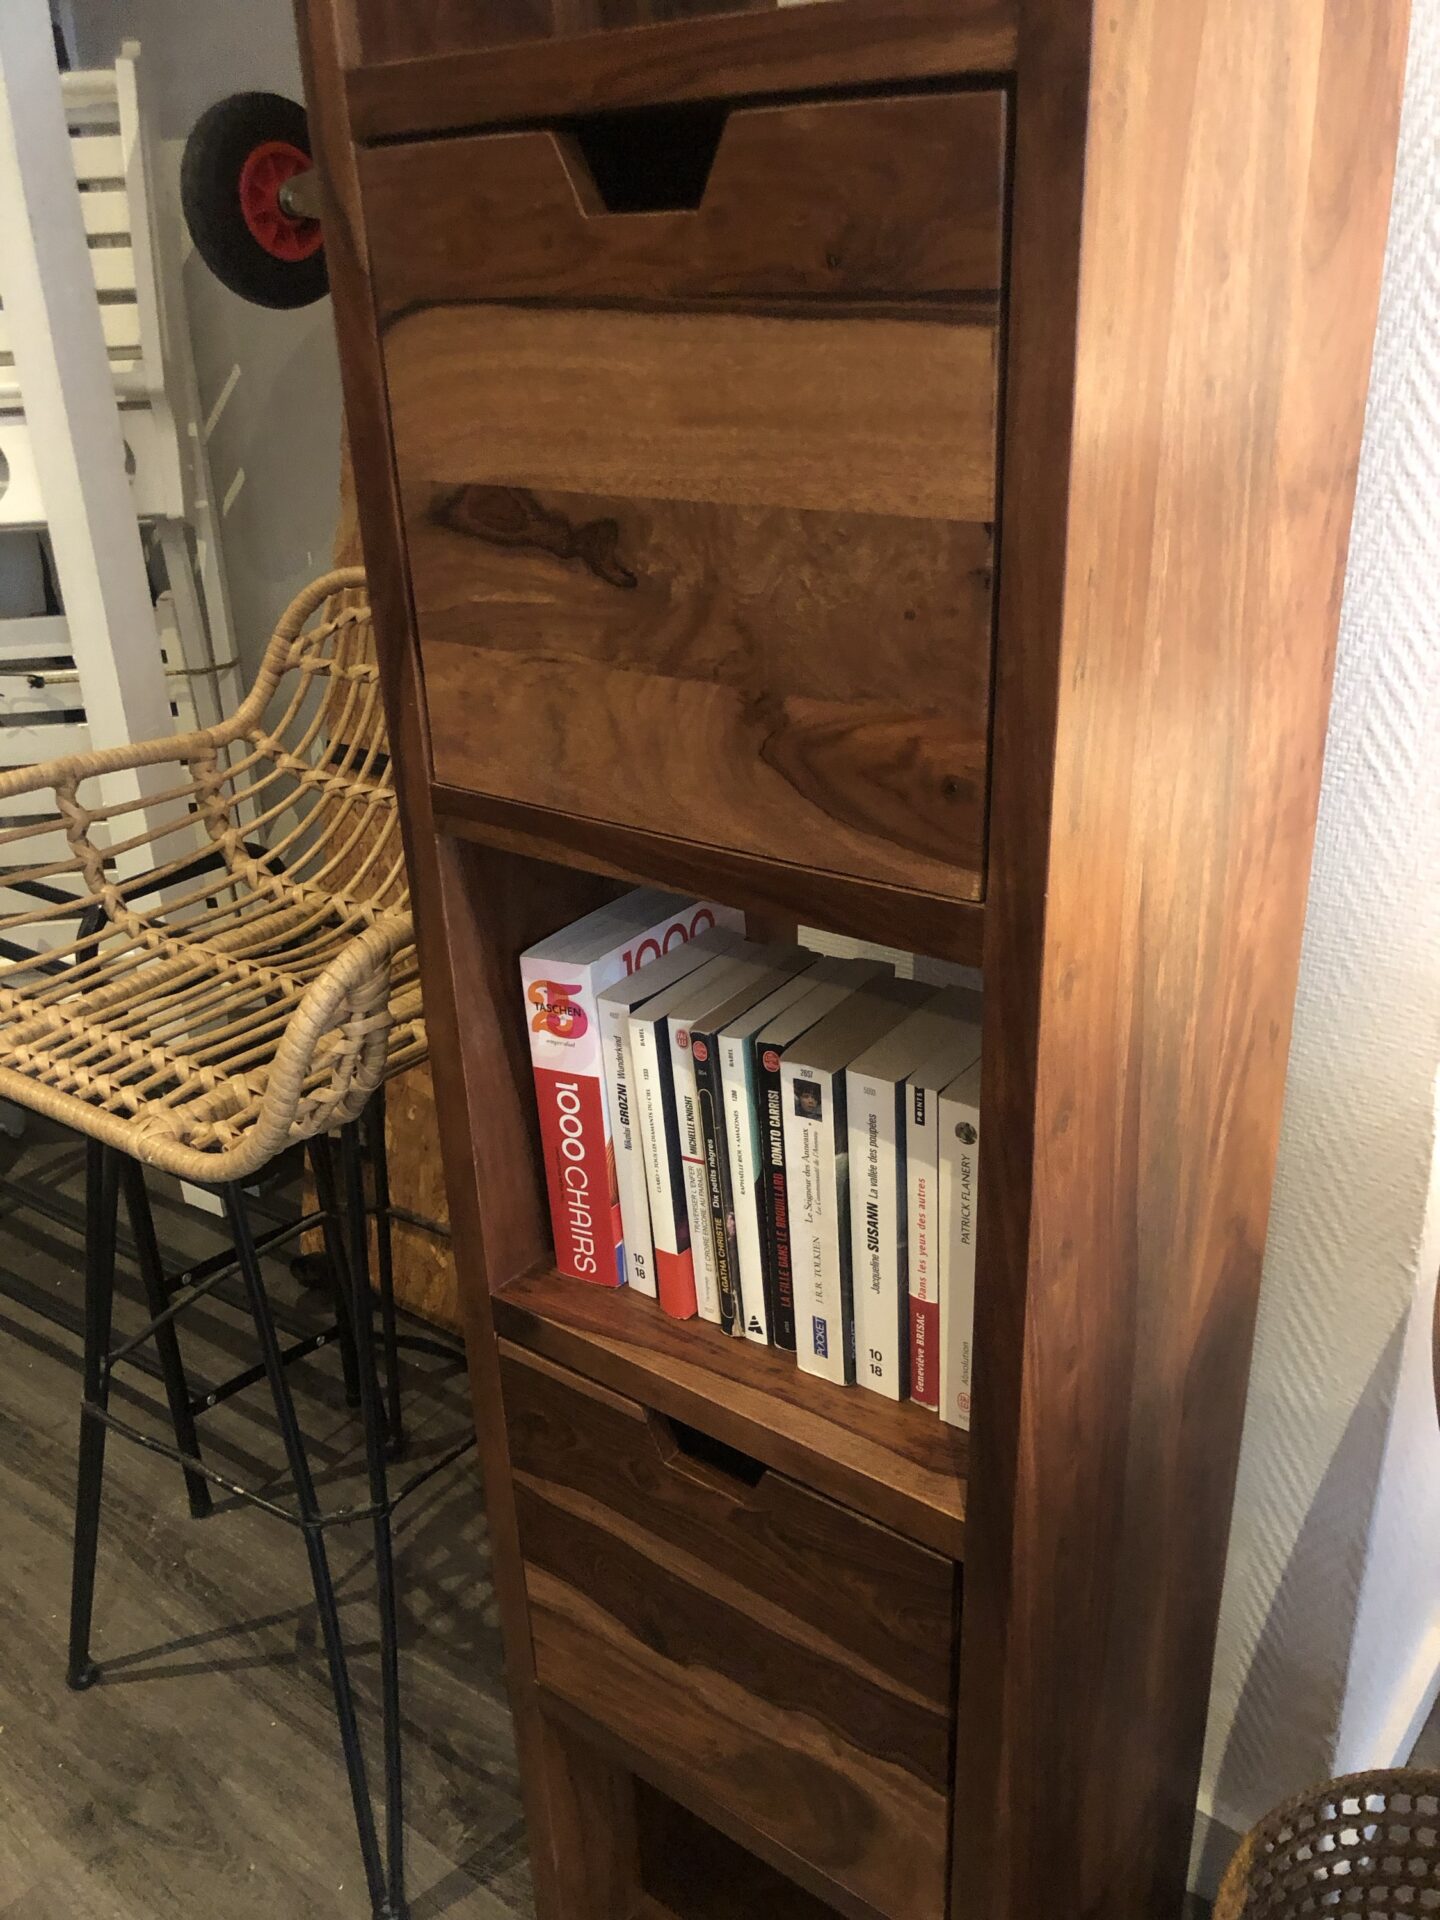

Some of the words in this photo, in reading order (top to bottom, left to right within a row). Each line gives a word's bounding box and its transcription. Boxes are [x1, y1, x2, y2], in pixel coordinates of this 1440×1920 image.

[534, 1001, 582, 1017] TASCHEN
[613, 1035, 626, 1080] Wunderkind
[616, 1083, 630, 1126] GROZNI
[685, 1096, 695, 1122] KNIGHT
[768, 1089, 781, 1128] CARRISI
[555, 1081, 586, 1162] 1000
[868, 1113, 879, 1148] poupées
[622, 1126, 632, 1151] Nikolai
[687, 1121, 697, 1155] MICHELLE
[770, 1128, 783, 1167] DONATO
[801, 1129, 809, 1163] Anneaux
[707, 1138, 717, 1170] nègres
[868, 1147, 878, 1164] des
[697, 1168, 705, 1196] PARADIS
[708, 1170, 718, 1194] petits
[802, 1165, 811, 1177] des
[868, 1165, 878, 1188] vallée
[961, 1154, 971, 1201] FLANERY
[712, 1193, 720, 1208] Dix
[773, 1173, 787, 1228] BROUILLARD
[802, 1179, 812, 1211] Seigneur
[868, 1188, 878, 1200] La
[917, 1178, 926, 1210] autres
[564, 1165, 597, 1274] CHAIRS
[691, 1193, 700, 1233] TRAVERSER
[700, 1210, 708, 1236] ENCORE
[804, 1212, 813, 1223] Le
[917, 1211, 926, 1230] des
[961, 1202, 971, 1245] PATRICK
[714, 1217, 726, 1259] CHRISTIE
[777, 1230, 786, 1241] LE
[866, 1202, 880, 1253] SUSANN
[633, 1252, 645, 1265] 10
[702, 1237, 711, 1261] CROIRE
[778, 1244, 788, 1268] DANS
[812, 1236, 822, 1278] TOLKIEN
[918, 1233, 929, 1257] yeux
[634, 1266, 646, 1280] 18
[705, 1262, 712, 1272] ET
[718, 1259, 730, 1294] AGATHA
[870, 1254, 881, 1294] Jacqueline
[917, 1259, 927, 1274] les
[778, 1269, 790, 1294] FILLE
[917, 1277, 927, 1300] Dans
[781, 1297, 791, 1308] LA
[815, 1317, 827, 1357] POCKET
[915, 1312, 925, 1346] BRISAC
[868, 1348, 883, 1362] 10
[960, 1341, 970, 1386] Absolution
[869, 1363, 883, 1377] 18
[916, 1347, 925, 1393] Geneviève
